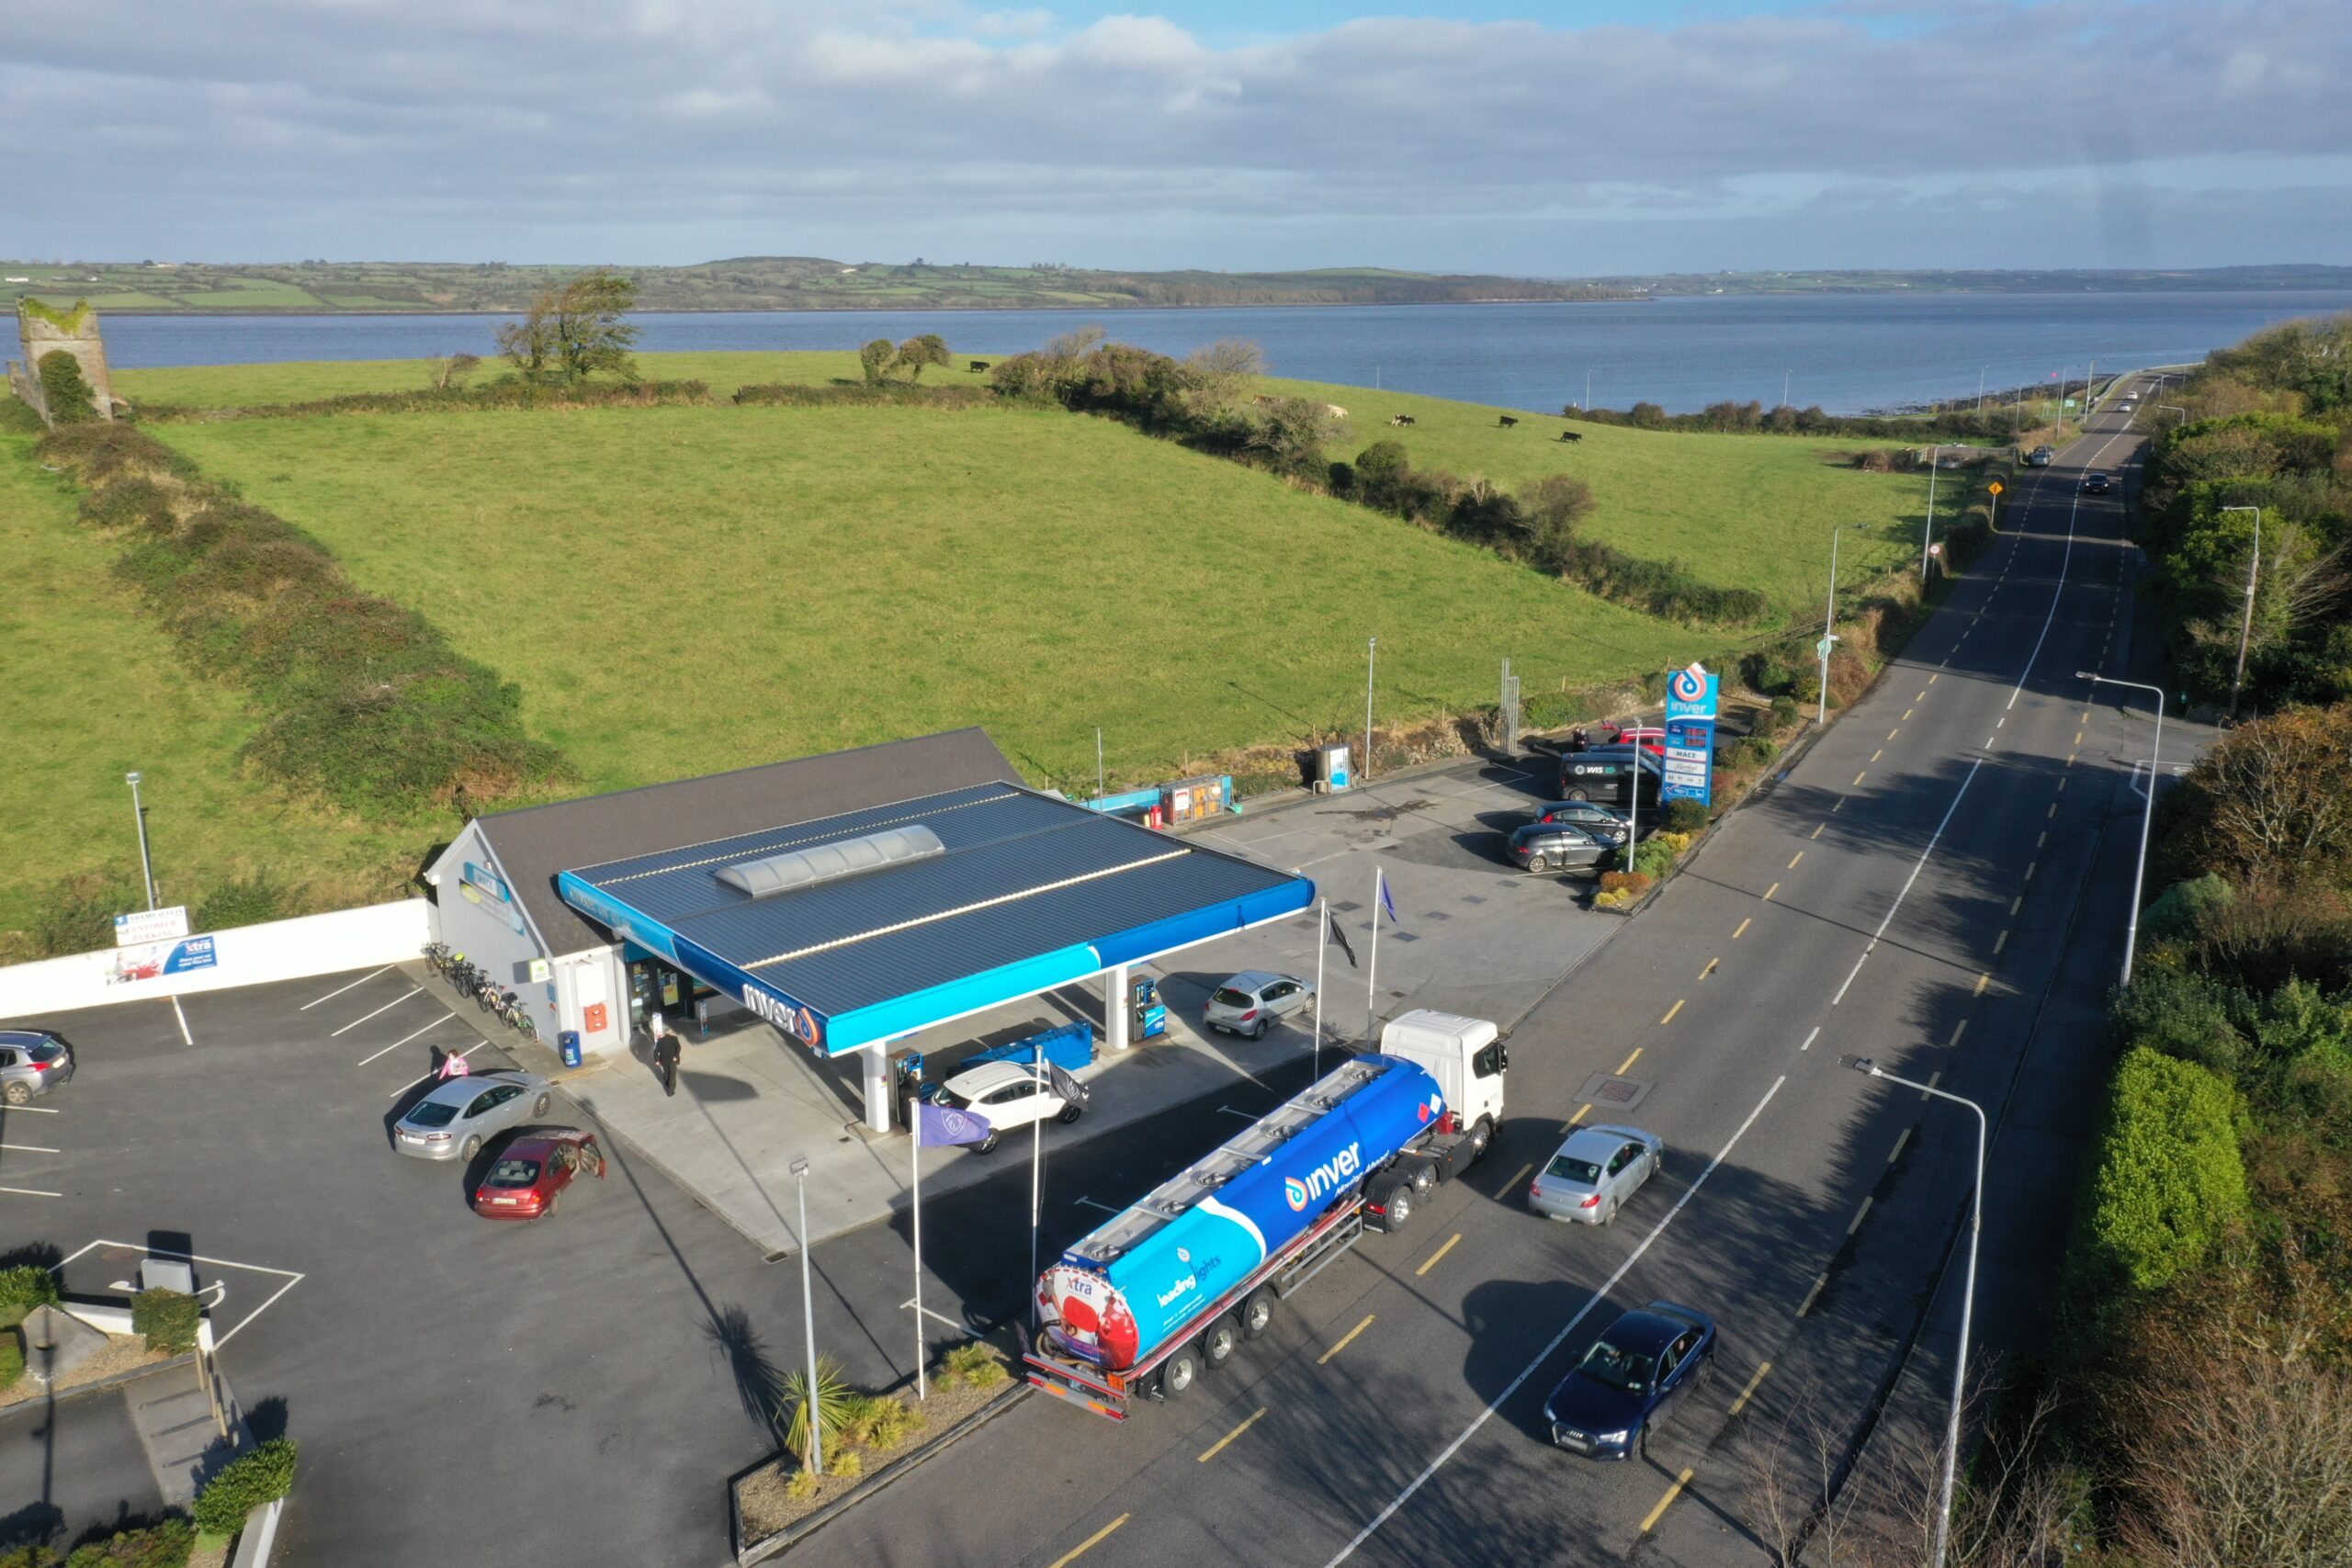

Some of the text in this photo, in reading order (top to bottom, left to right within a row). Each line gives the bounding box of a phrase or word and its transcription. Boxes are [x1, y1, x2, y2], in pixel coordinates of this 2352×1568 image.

[1671, 702, 1707, 714] inver
[1676, 750, 1697, 759] MACE
[742, 983, 796, 1033] inver
[1306, 1141, 1360, 1201] inver
